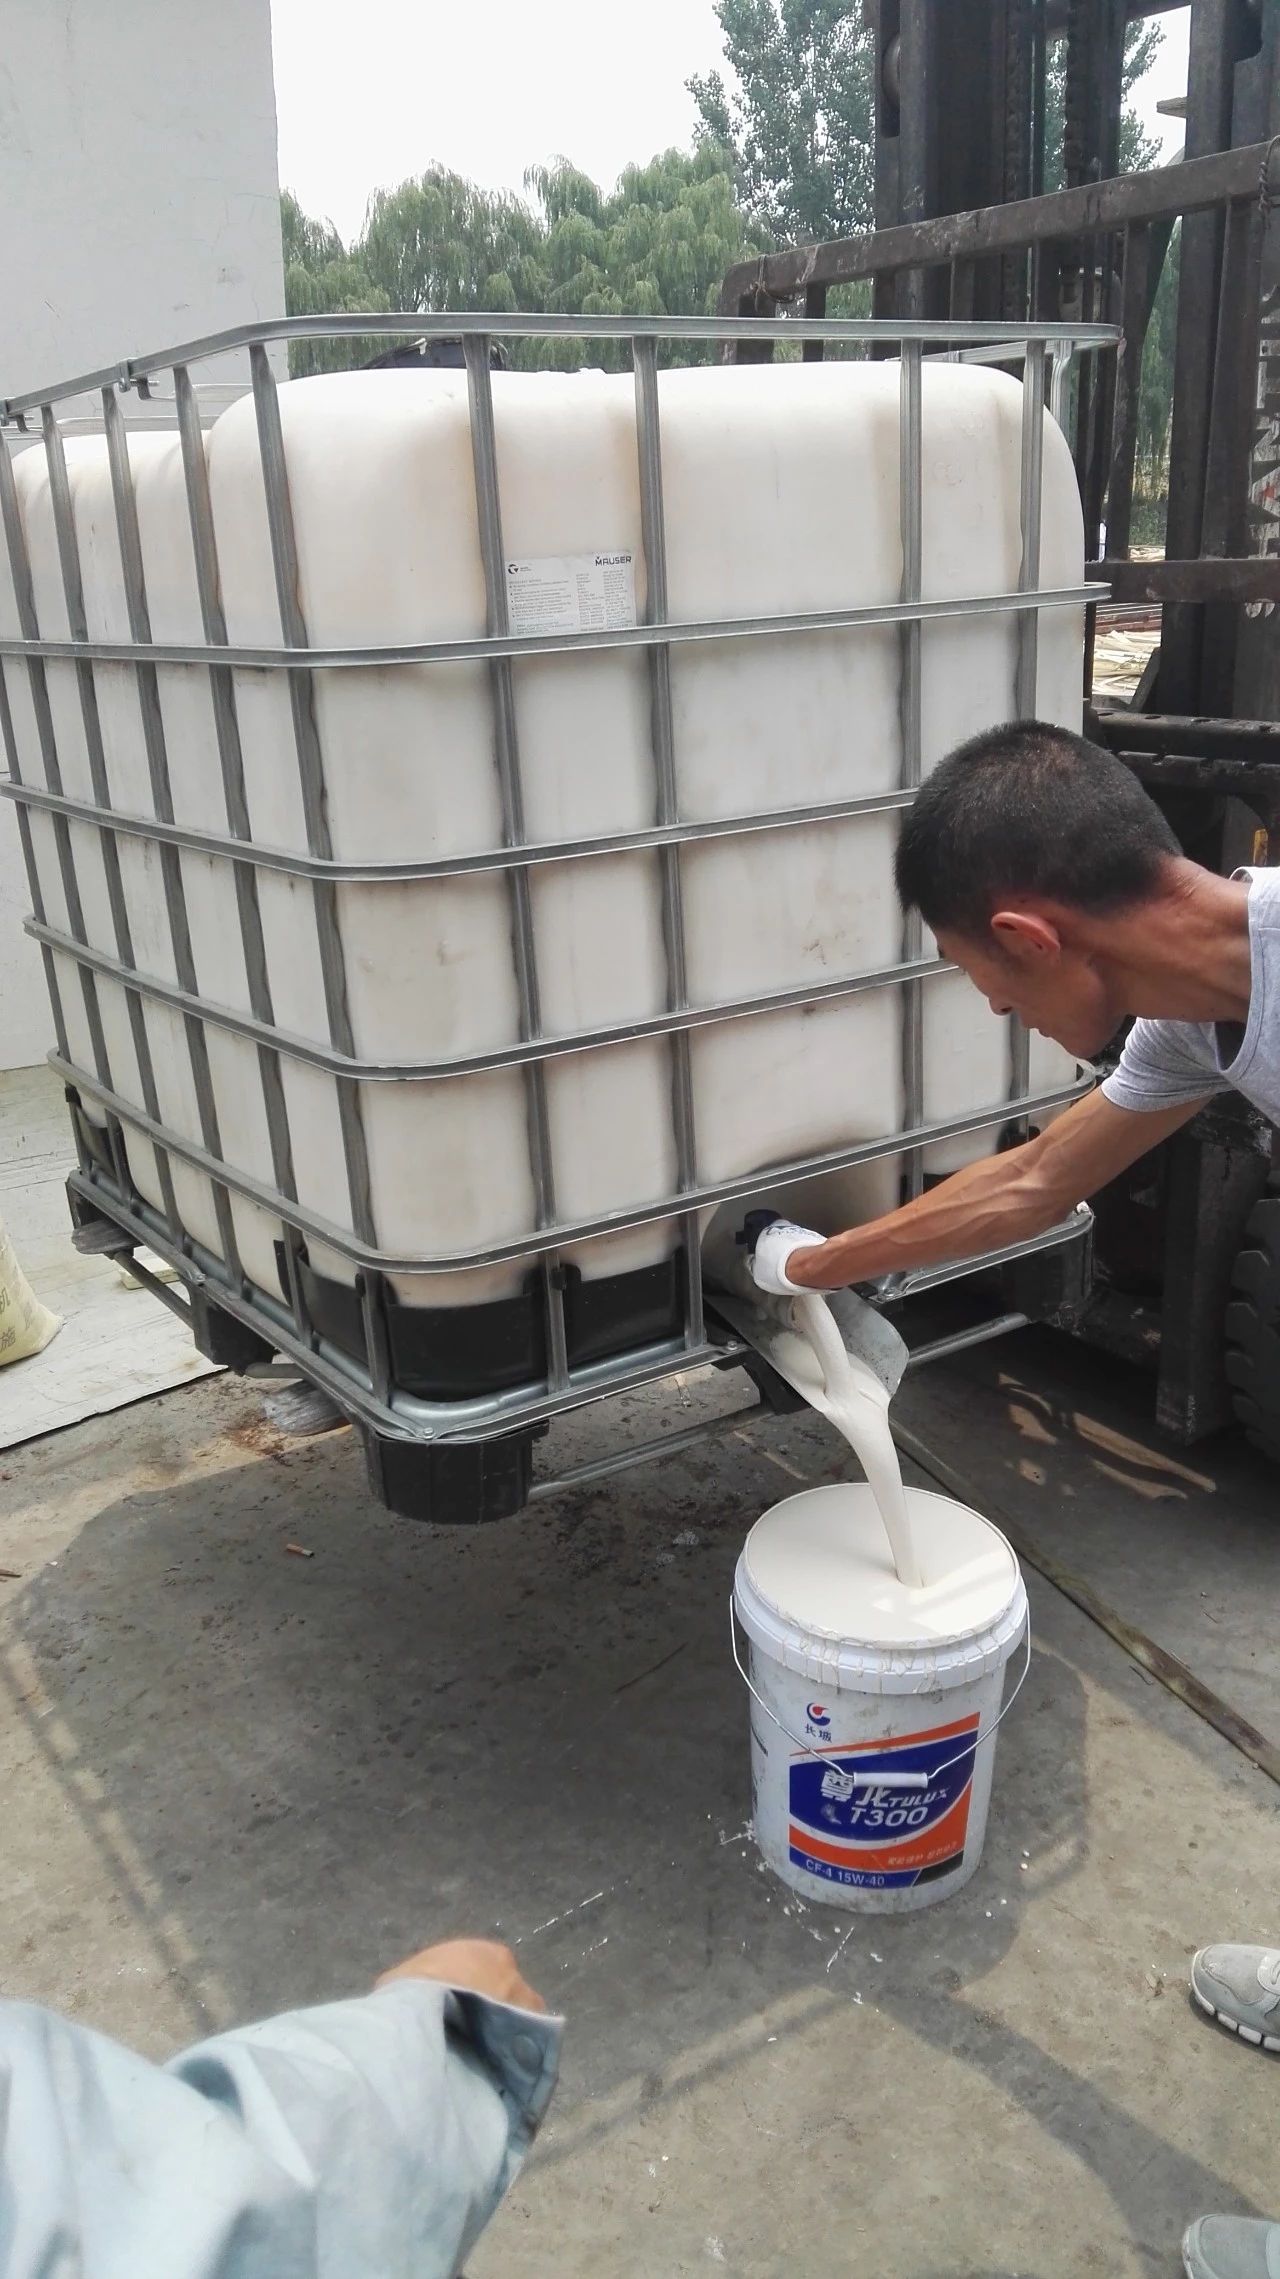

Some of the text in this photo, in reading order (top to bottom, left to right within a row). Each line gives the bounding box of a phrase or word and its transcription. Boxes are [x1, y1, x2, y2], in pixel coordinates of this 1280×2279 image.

[595, 556, 632, 567] MAUSER
[851, 1806, 929, 1827] T300
[806, 1859, 885, 1886] CF-4 15W-40
